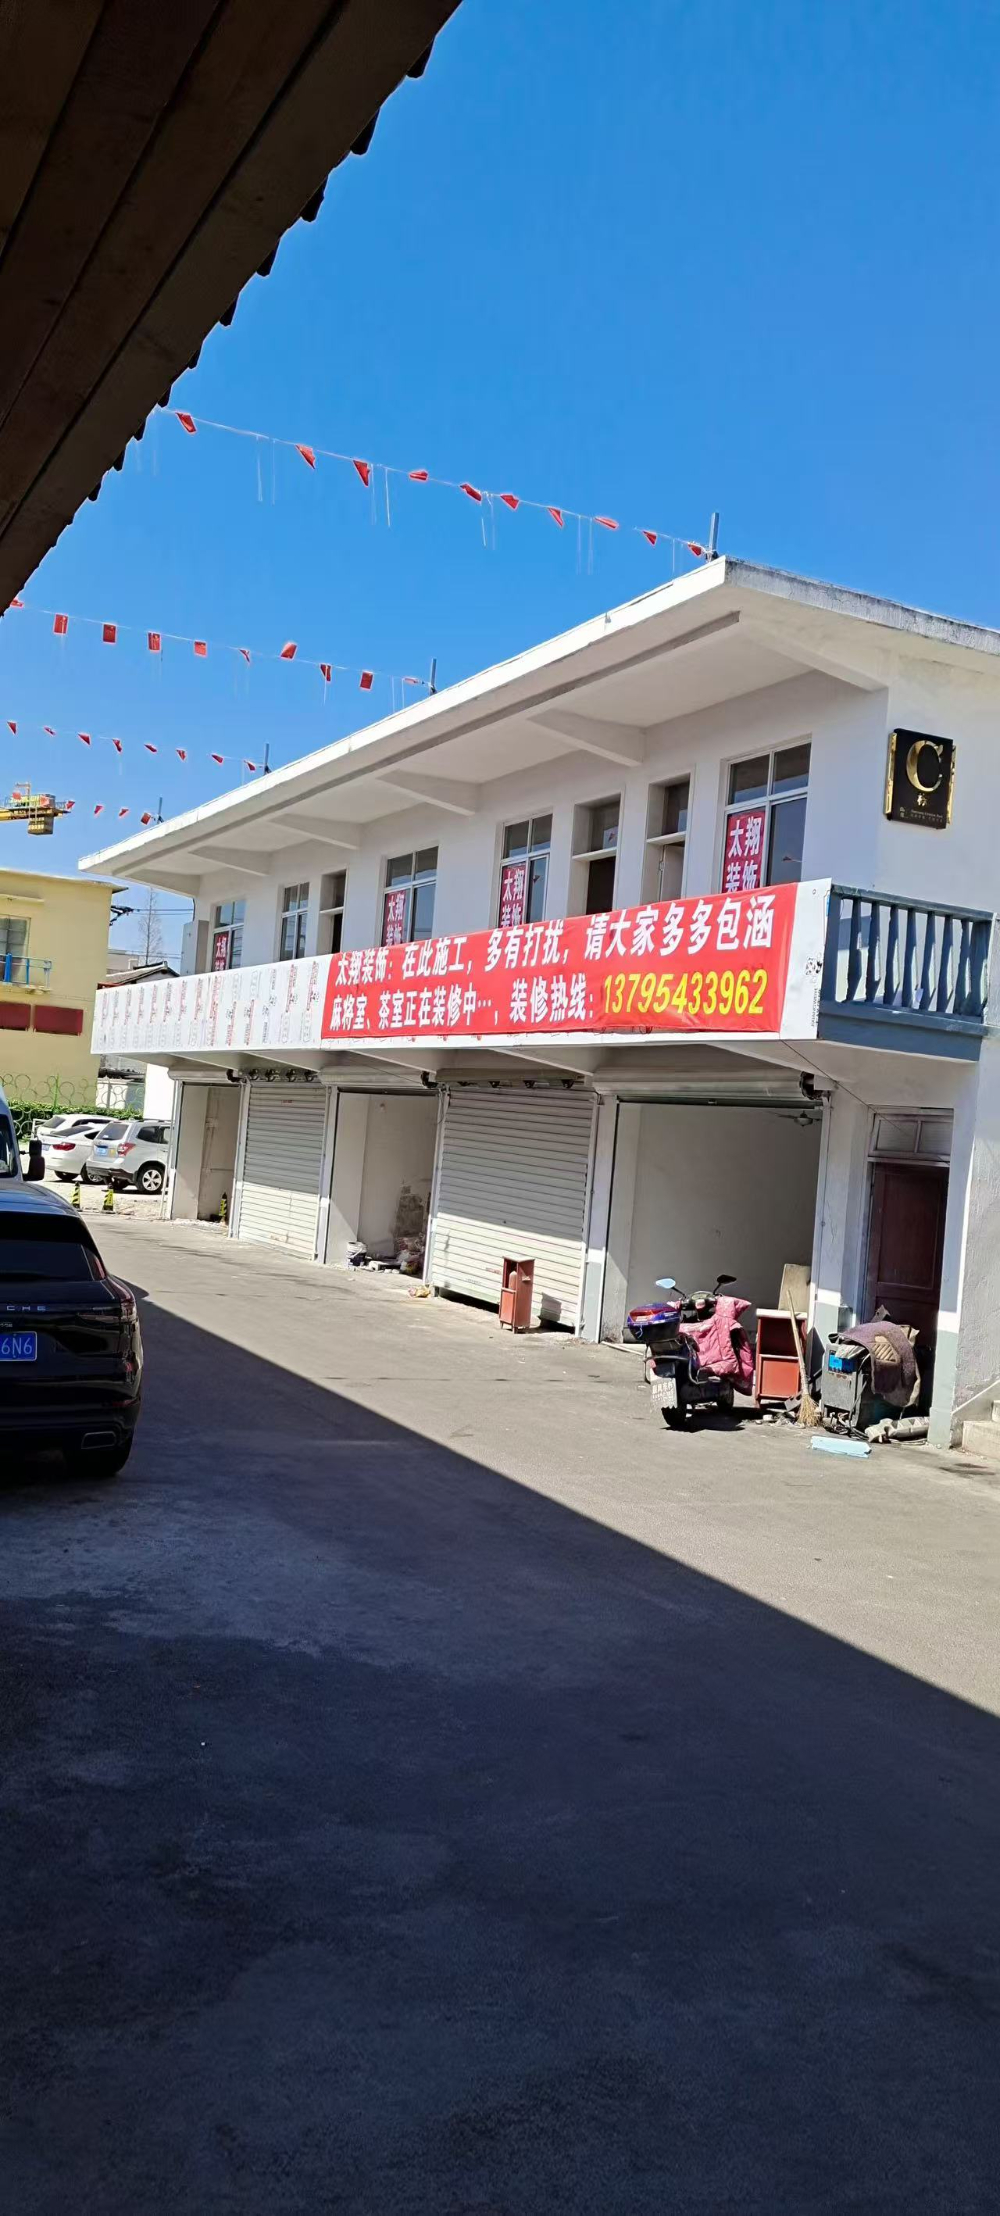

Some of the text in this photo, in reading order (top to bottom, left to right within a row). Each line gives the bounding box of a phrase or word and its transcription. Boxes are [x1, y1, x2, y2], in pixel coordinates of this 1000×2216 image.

[906, 740, 944, 792] C
[728, 816, 762, 858] 太翔
[503, 869, 524, 901] 太翔
[725, 860, 758, 893] 装饰
[387, 893, 405, 922] 太翔
[1, 1337, 33, 1355] 6N6
